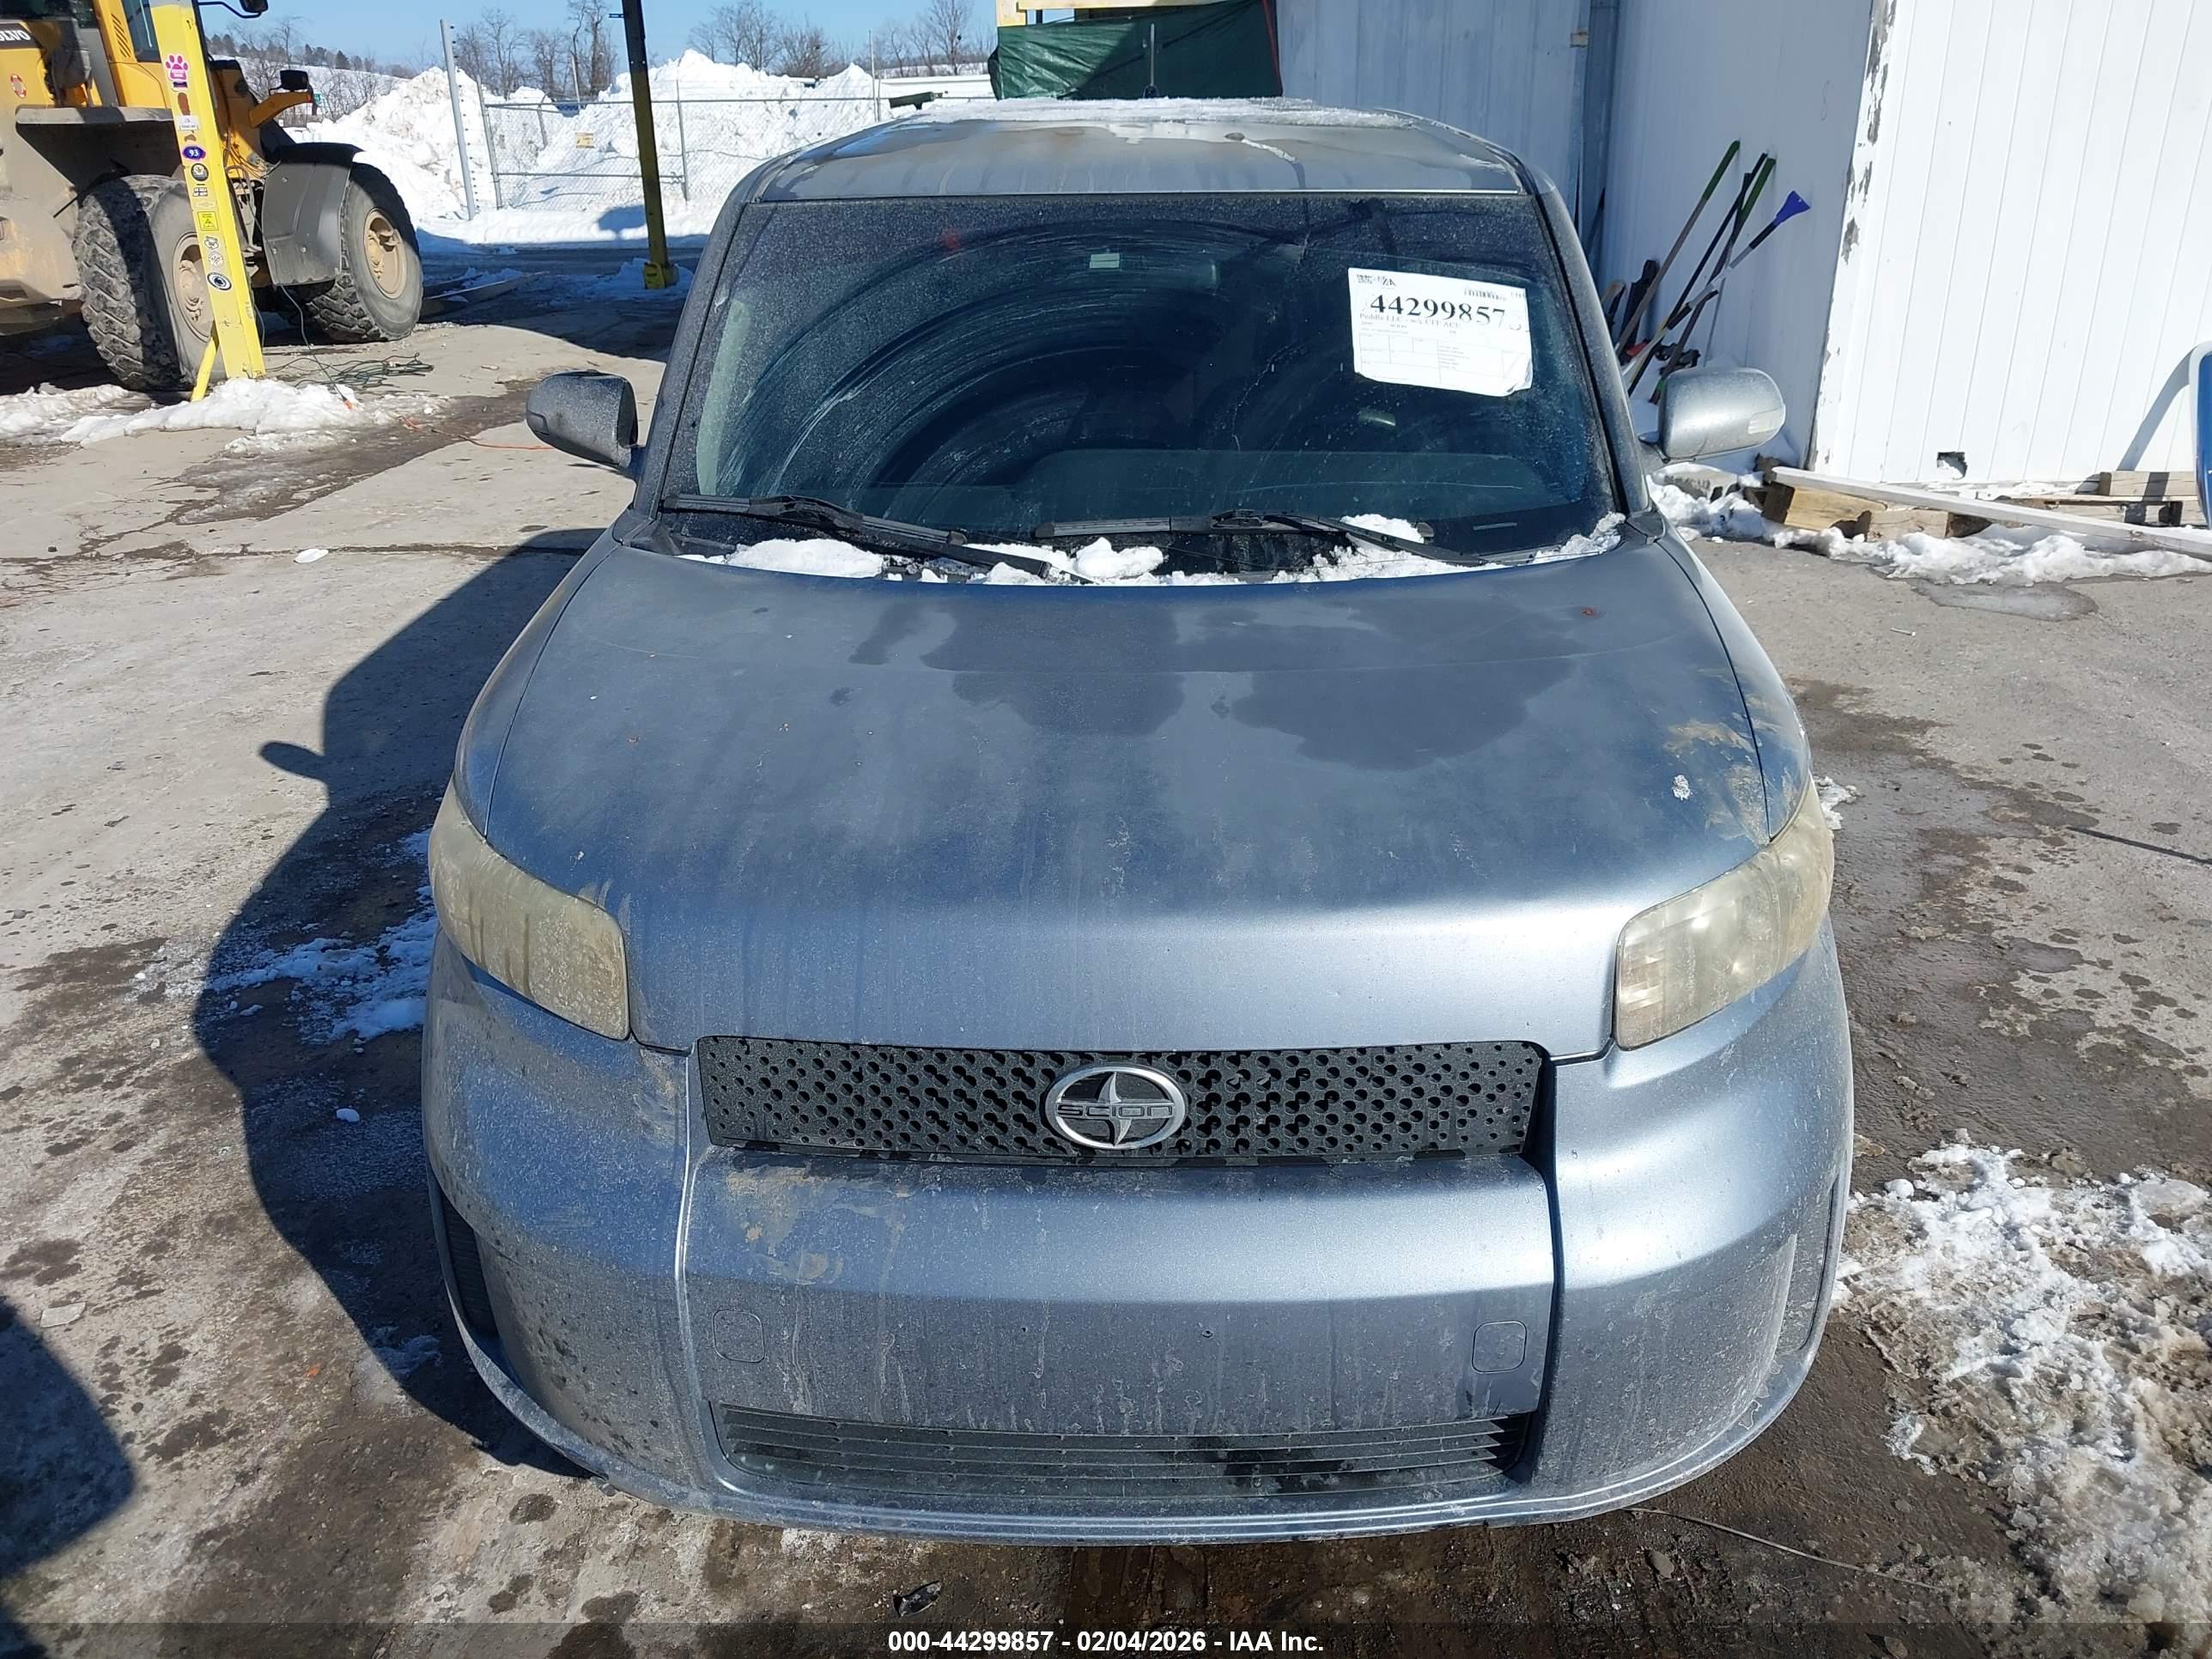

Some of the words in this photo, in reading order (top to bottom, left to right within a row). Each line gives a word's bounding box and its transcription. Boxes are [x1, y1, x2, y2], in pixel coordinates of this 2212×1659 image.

[189, 149, 199, 157] 93
[1370, 294, 1505, 329] 44299857
[1057, 1104, 1173, 1118] SCION
